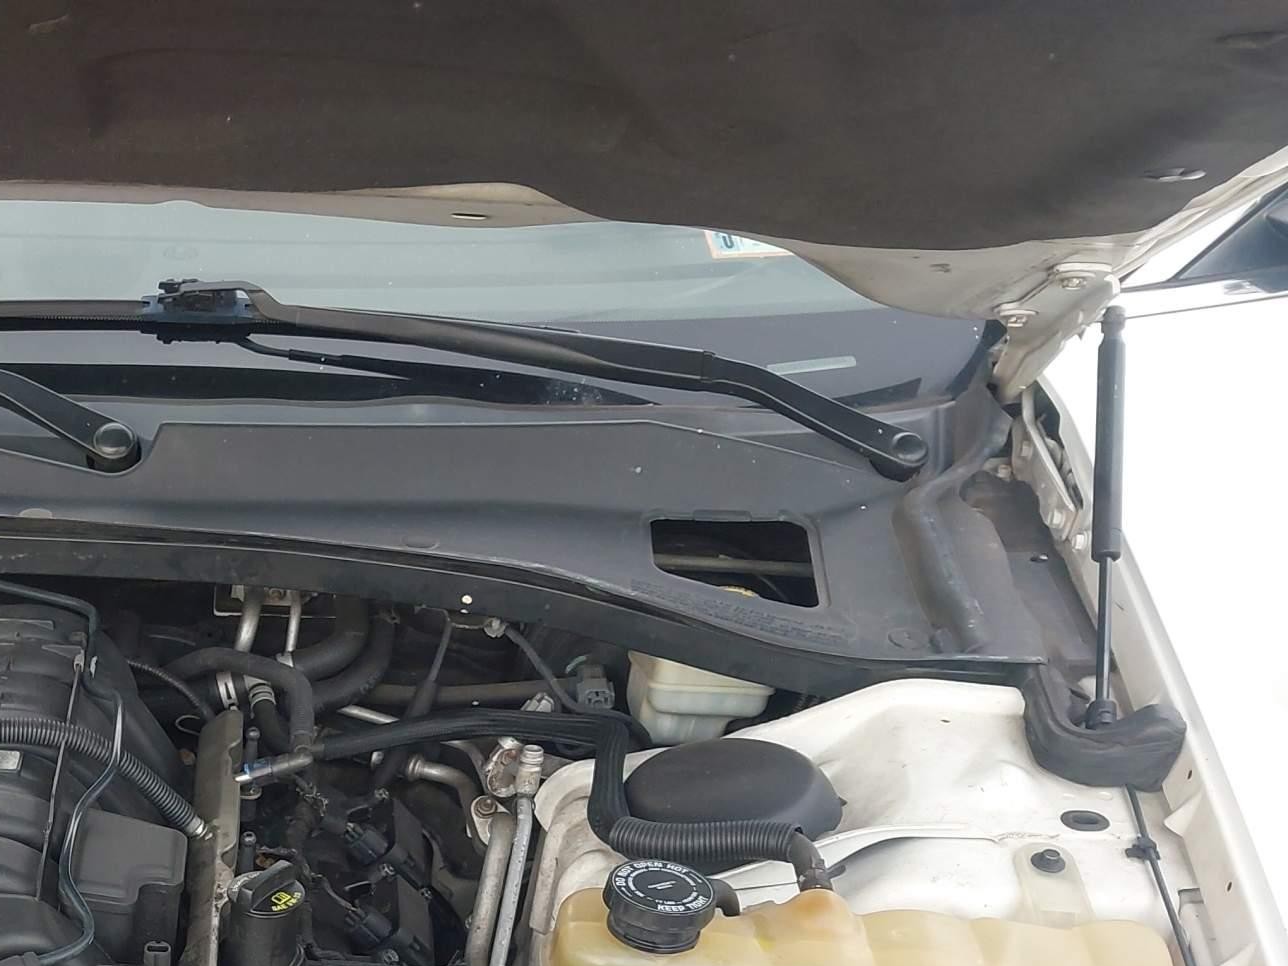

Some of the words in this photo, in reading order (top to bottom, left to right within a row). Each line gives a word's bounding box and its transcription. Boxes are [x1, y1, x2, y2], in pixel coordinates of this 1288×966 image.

[633, 861, 663, 869] OPEN
[666, 863, 689, 874] HOT
[617, 865, 634, 877] NOT
[615, 877, 626, 886] DO
[657, 904, 685, 912] KEEP
[686, 895, 709, 910] TIGHT
